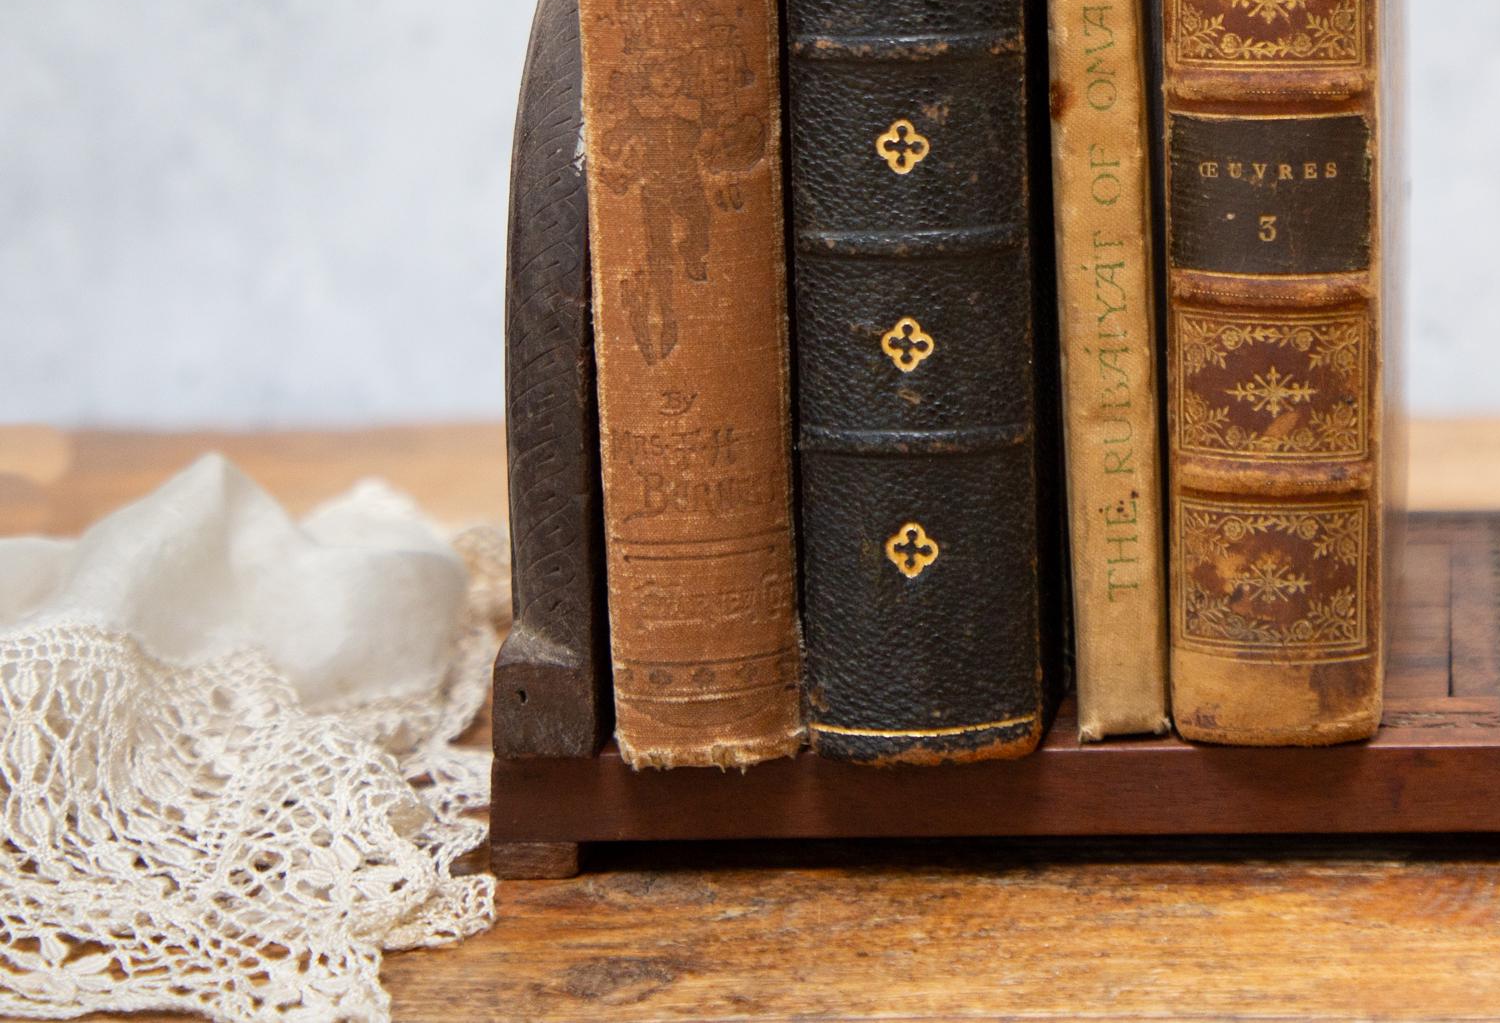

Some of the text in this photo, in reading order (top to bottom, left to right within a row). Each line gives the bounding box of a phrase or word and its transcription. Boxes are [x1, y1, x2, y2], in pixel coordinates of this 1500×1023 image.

[1088, 142, 1122, 208] OF
[1198, 161, 1338, 180] ŒUVRES
[1258, 214, 1277, 242] 3
[1102, 499, 1139, 604] THE
